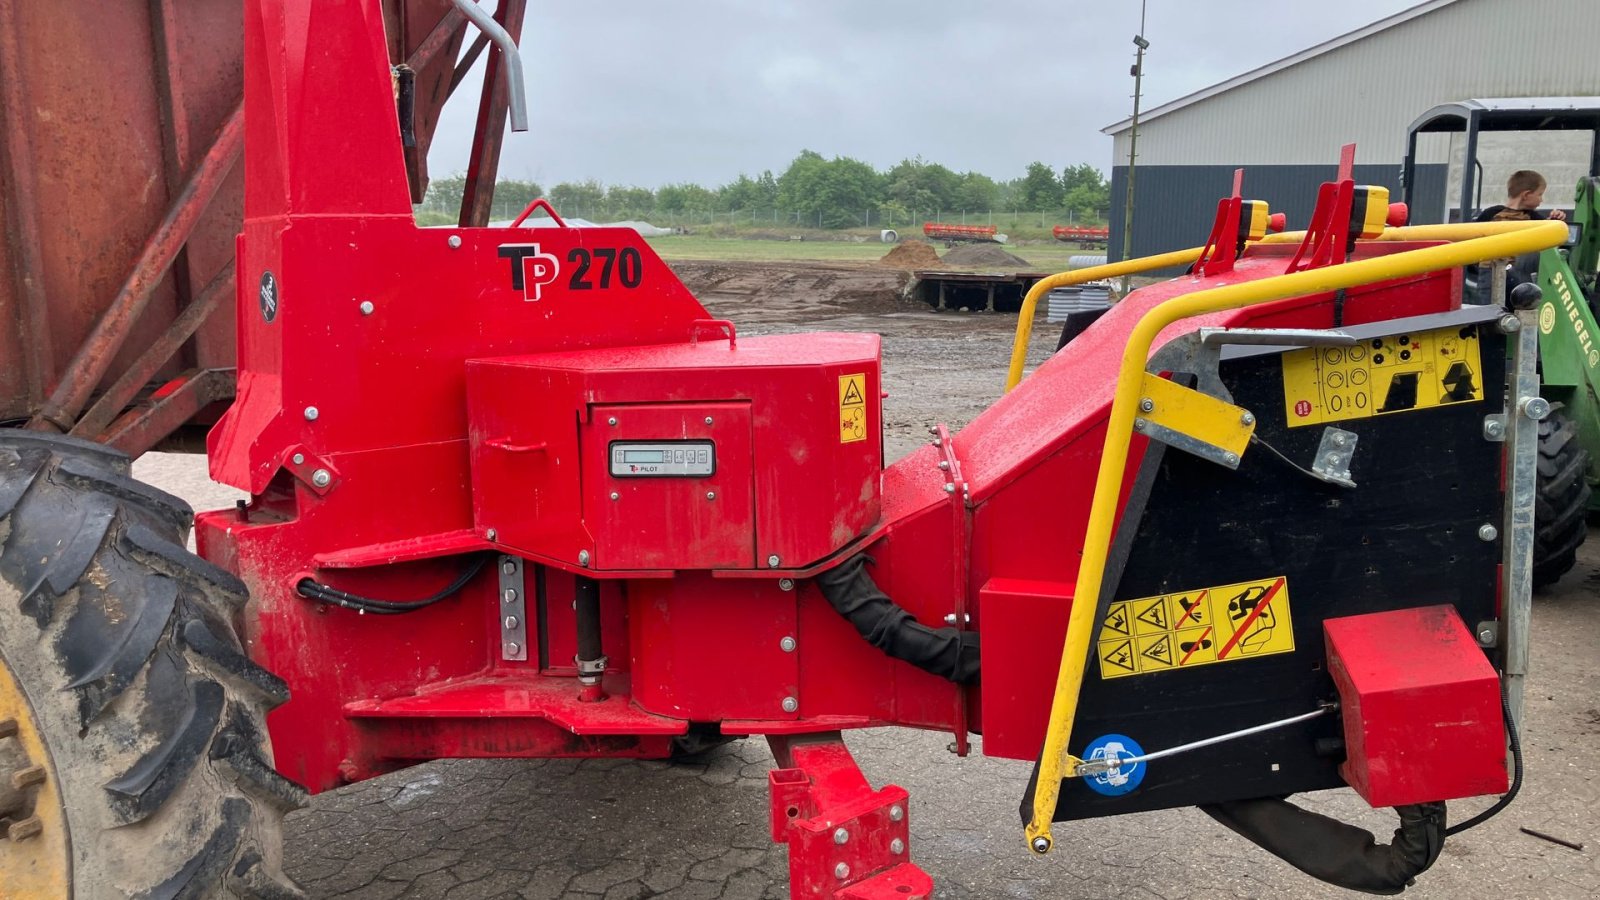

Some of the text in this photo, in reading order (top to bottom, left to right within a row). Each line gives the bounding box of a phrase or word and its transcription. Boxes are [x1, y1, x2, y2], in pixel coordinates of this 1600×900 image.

[498, 243, 642, 302] TP 270
[1553, 271, 1592, 355] STRIEGEL
